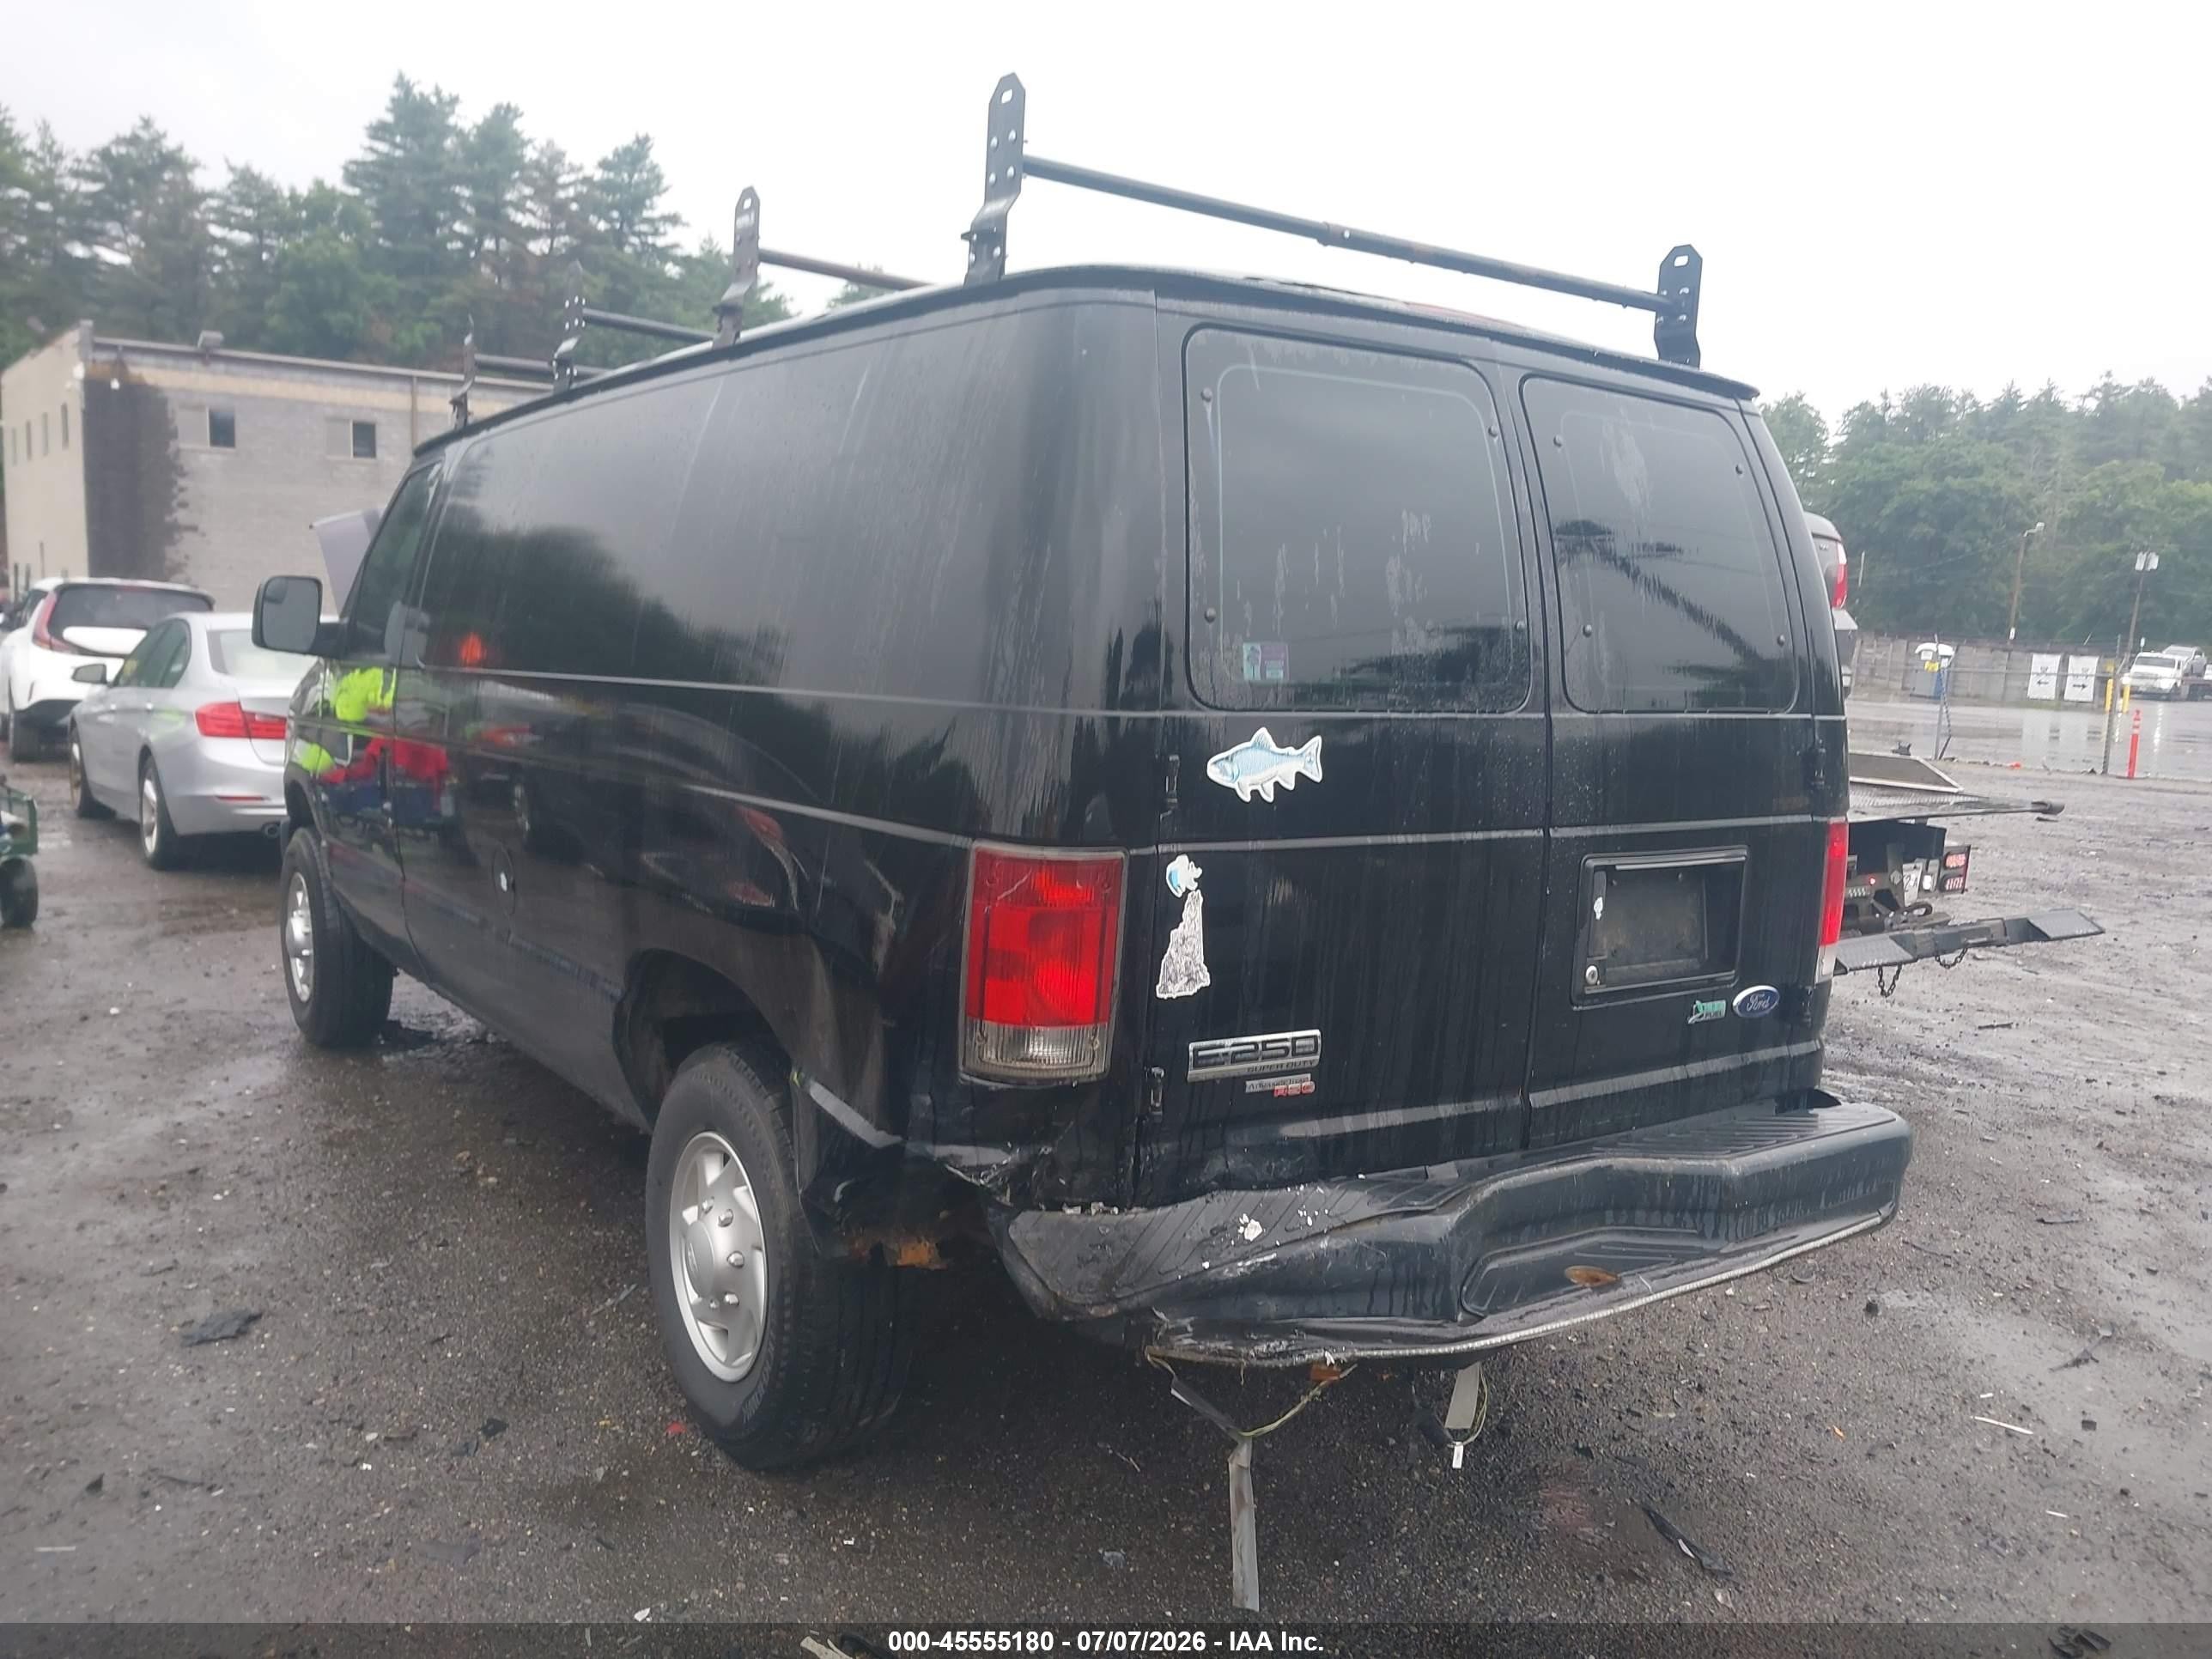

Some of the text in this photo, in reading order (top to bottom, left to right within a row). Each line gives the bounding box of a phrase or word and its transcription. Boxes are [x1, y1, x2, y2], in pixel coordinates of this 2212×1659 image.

[1746, 993, 1771, 1012] Ford
[1247, 1058, 1316, 1073] SUPER DUTY
